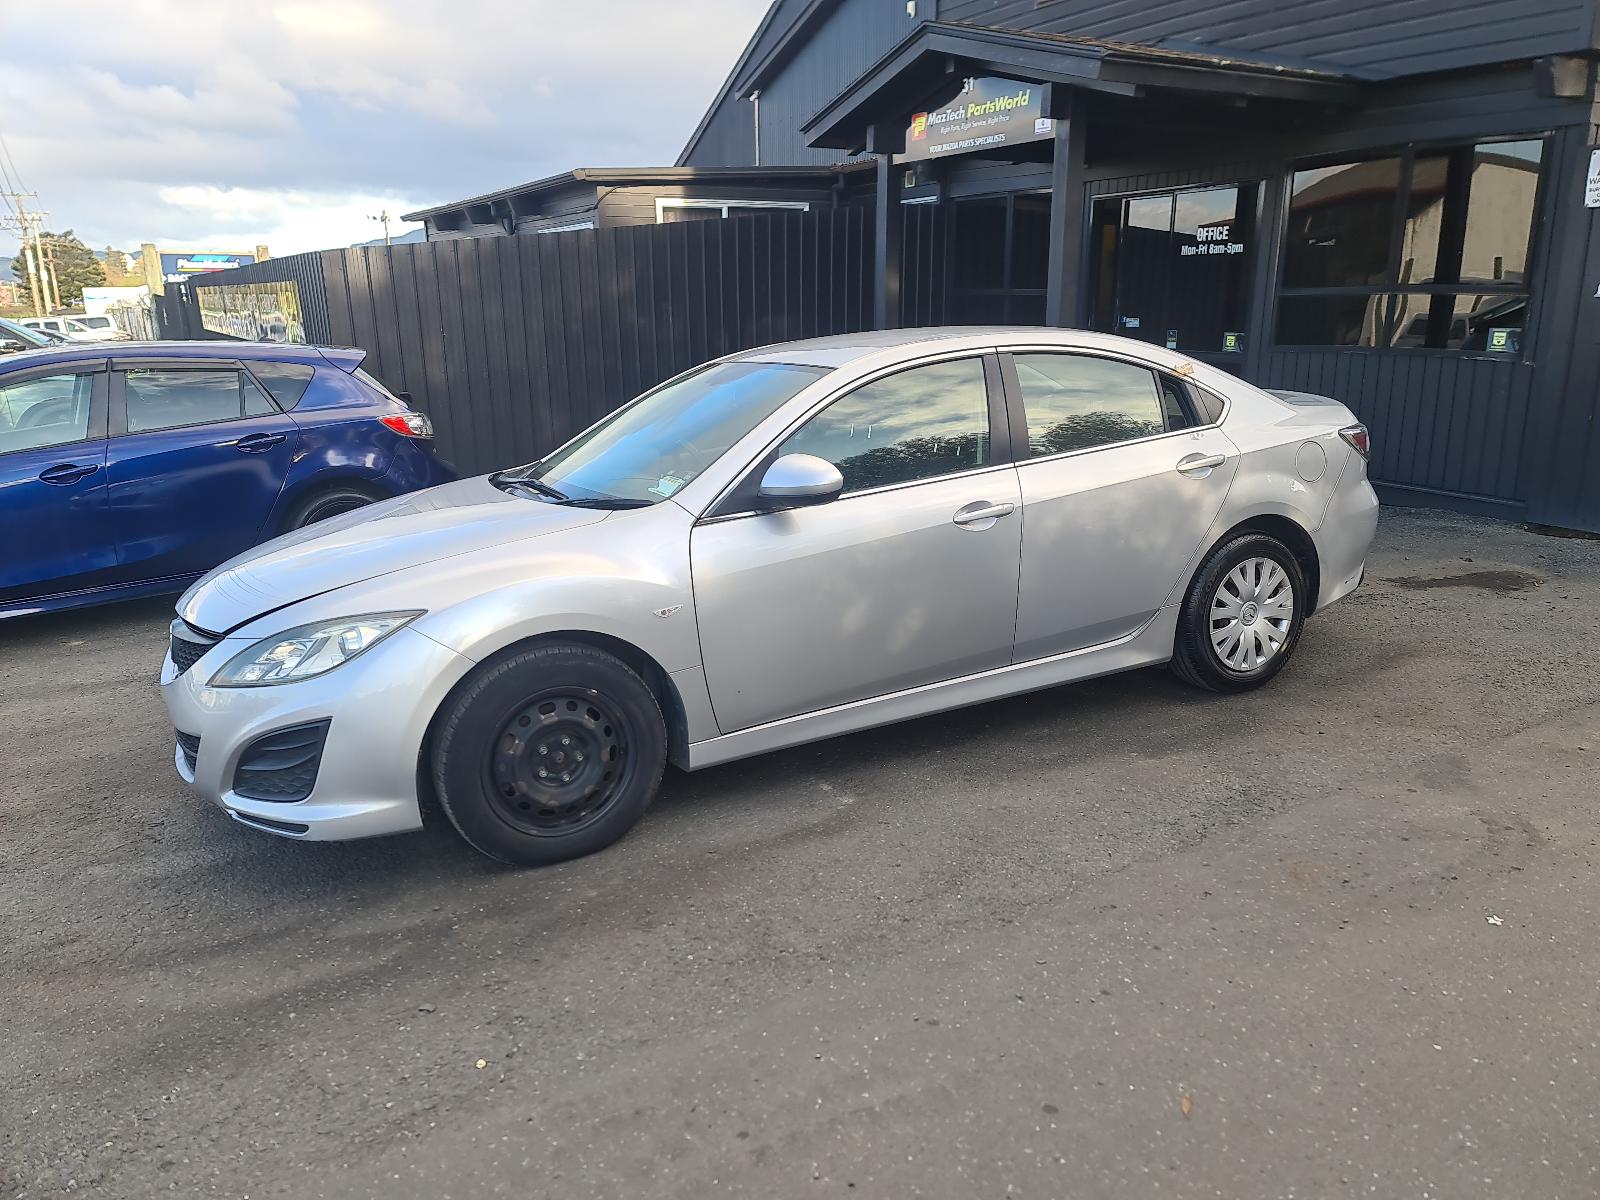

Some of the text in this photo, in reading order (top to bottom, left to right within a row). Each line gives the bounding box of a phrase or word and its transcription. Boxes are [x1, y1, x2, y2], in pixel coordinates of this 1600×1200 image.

[962, 77, 974, 93] 31
[927, 89, 1030, 126] MazTech PartsWorld
[958, 139, 974, 149] PARTS
[974, 133, 1006, 146] SPECIALISTS
[1197, 226, 1230, 242] OFFICE
[1181, 243, 1244, 256] Mon-Fri 8am-5pm
